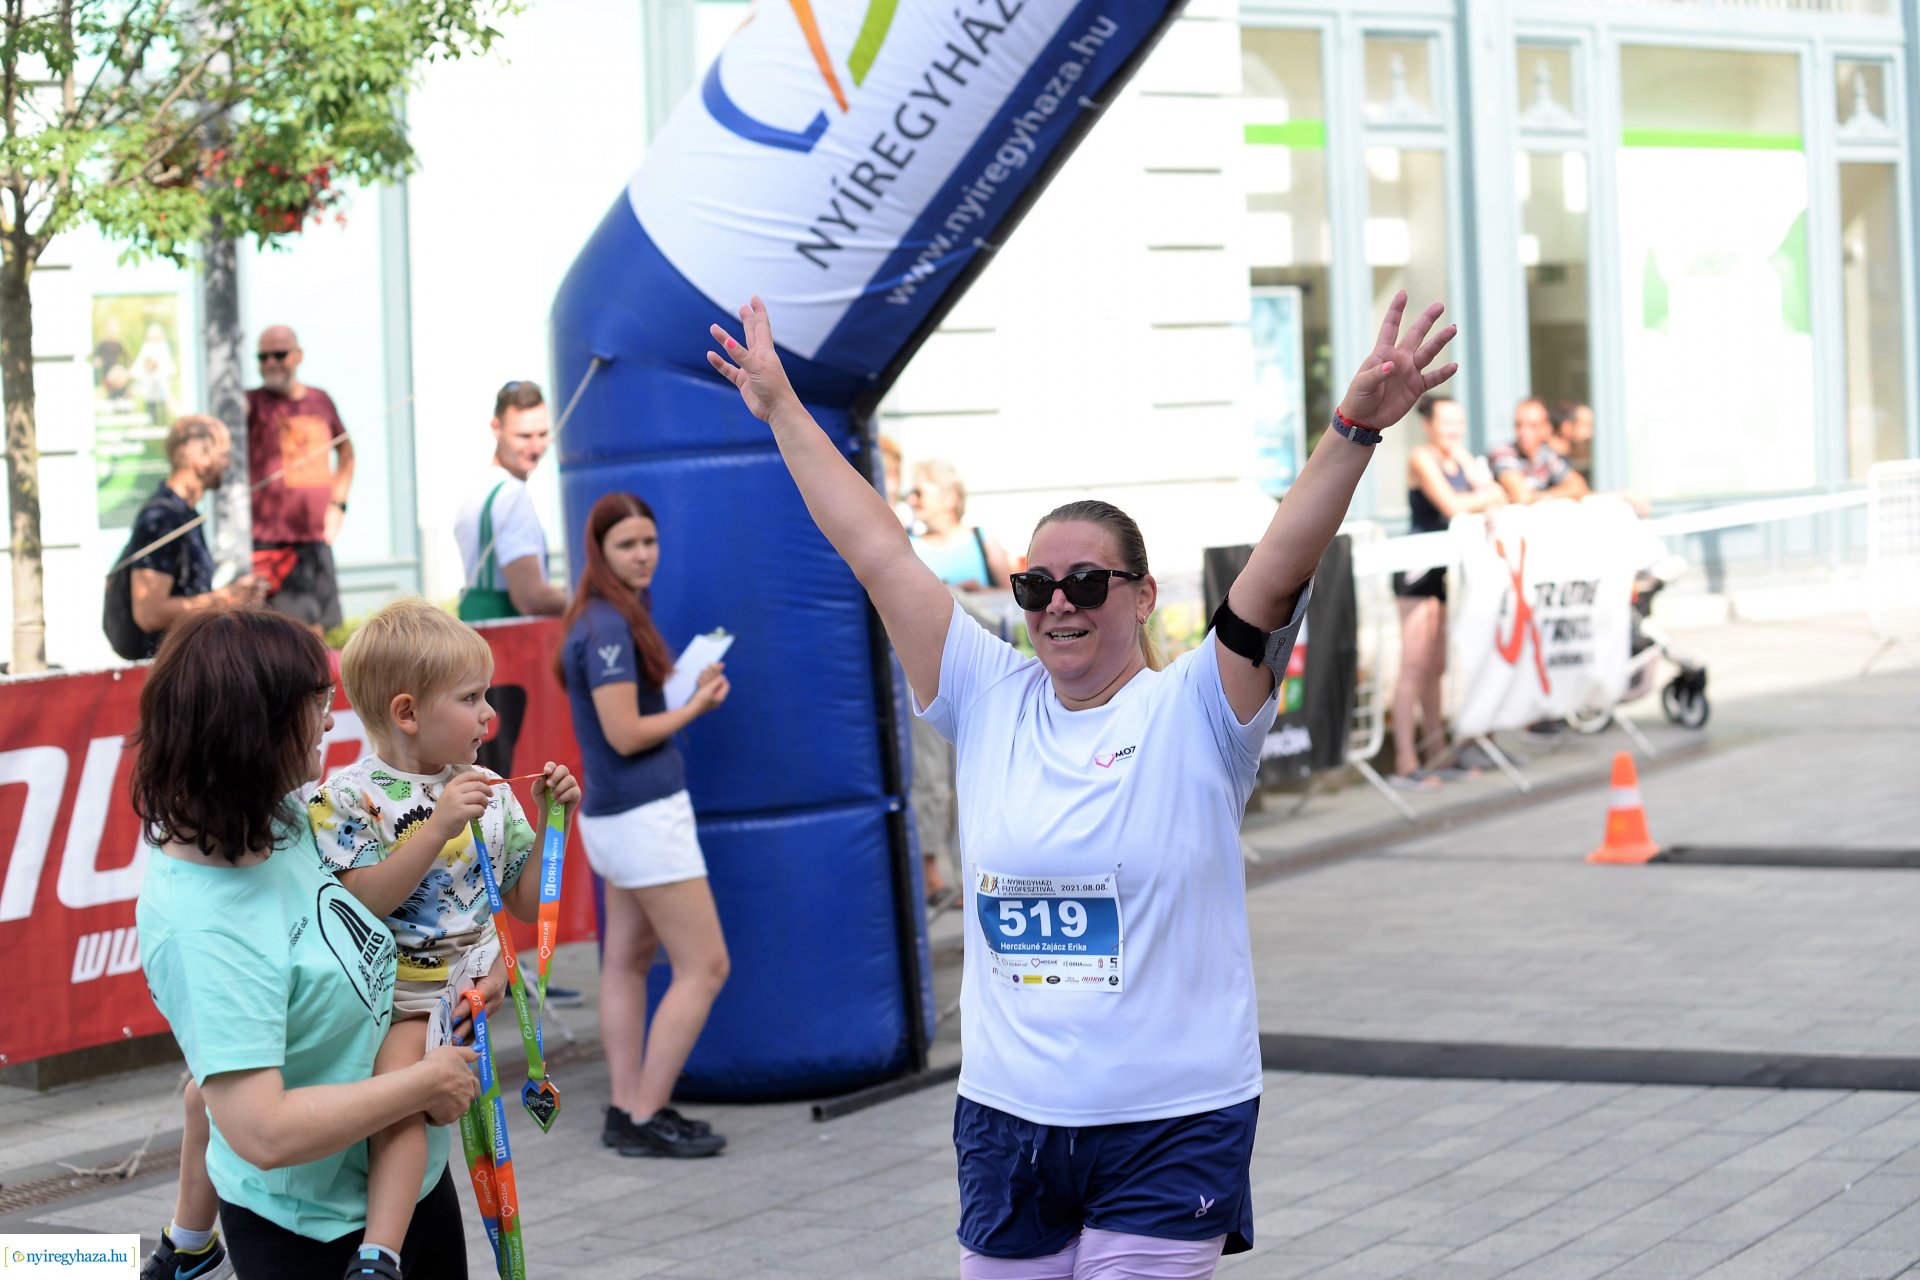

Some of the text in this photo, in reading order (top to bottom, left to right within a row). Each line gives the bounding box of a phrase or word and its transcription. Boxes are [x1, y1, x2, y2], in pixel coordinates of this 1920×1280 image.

[885, 15, 1119, 306] www.nyiregyhaza.hu
[1060, 883, 1108, 892] 2021.08.08.
[999, 900, 1088, 938] 519
[1068, 942, 1087, 951] Erika
